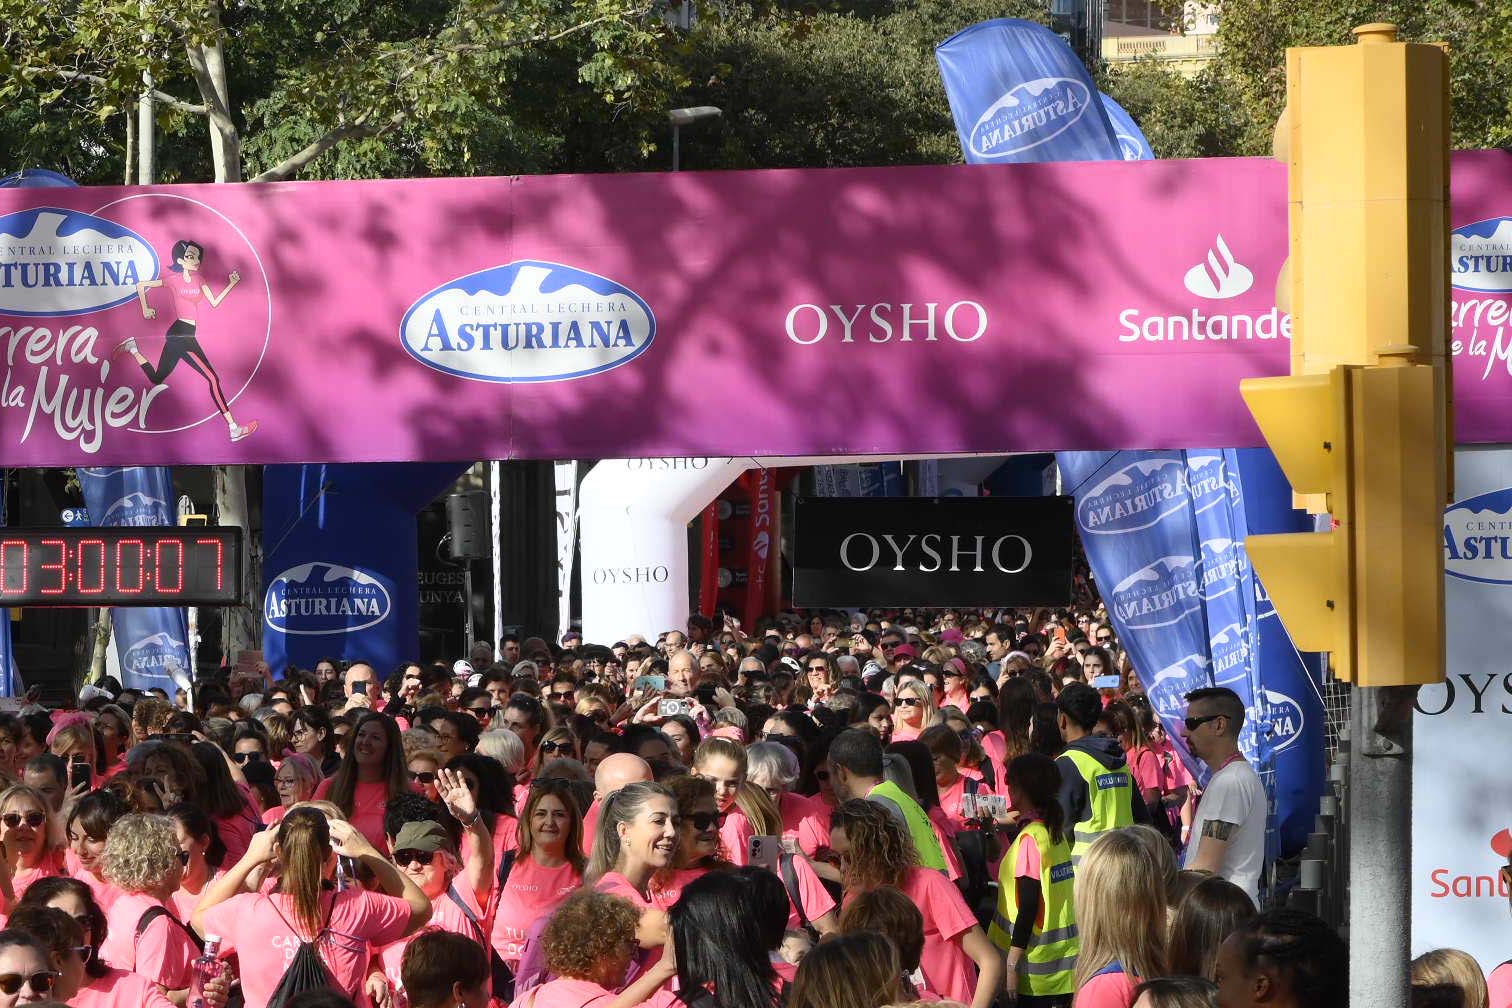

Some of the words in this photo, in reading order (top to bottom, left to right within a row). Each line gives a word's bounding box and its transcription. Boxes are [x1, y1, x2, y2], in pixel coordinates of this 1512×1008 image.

[62, 244, 134, 256] LECHERA
[459, 302, 537, 315] CENTRAL
[547, 300, 627, 314] LECHERA
[786, 300, 988, 345] OYSHO
[1119, 306, 1291, 342] Santande
[420, 308, 636, 352] ASTURIANA
[1, 367, 25, 408] la
[20, 361, 169, 453] Mujer
[0, 539, 223, 594] 03:00:07
[839, 532, 1033, 574] OYSHO
[593, 565, 670, 586] OYSHO
[268, 591, 381, 619] ASTURIANA
